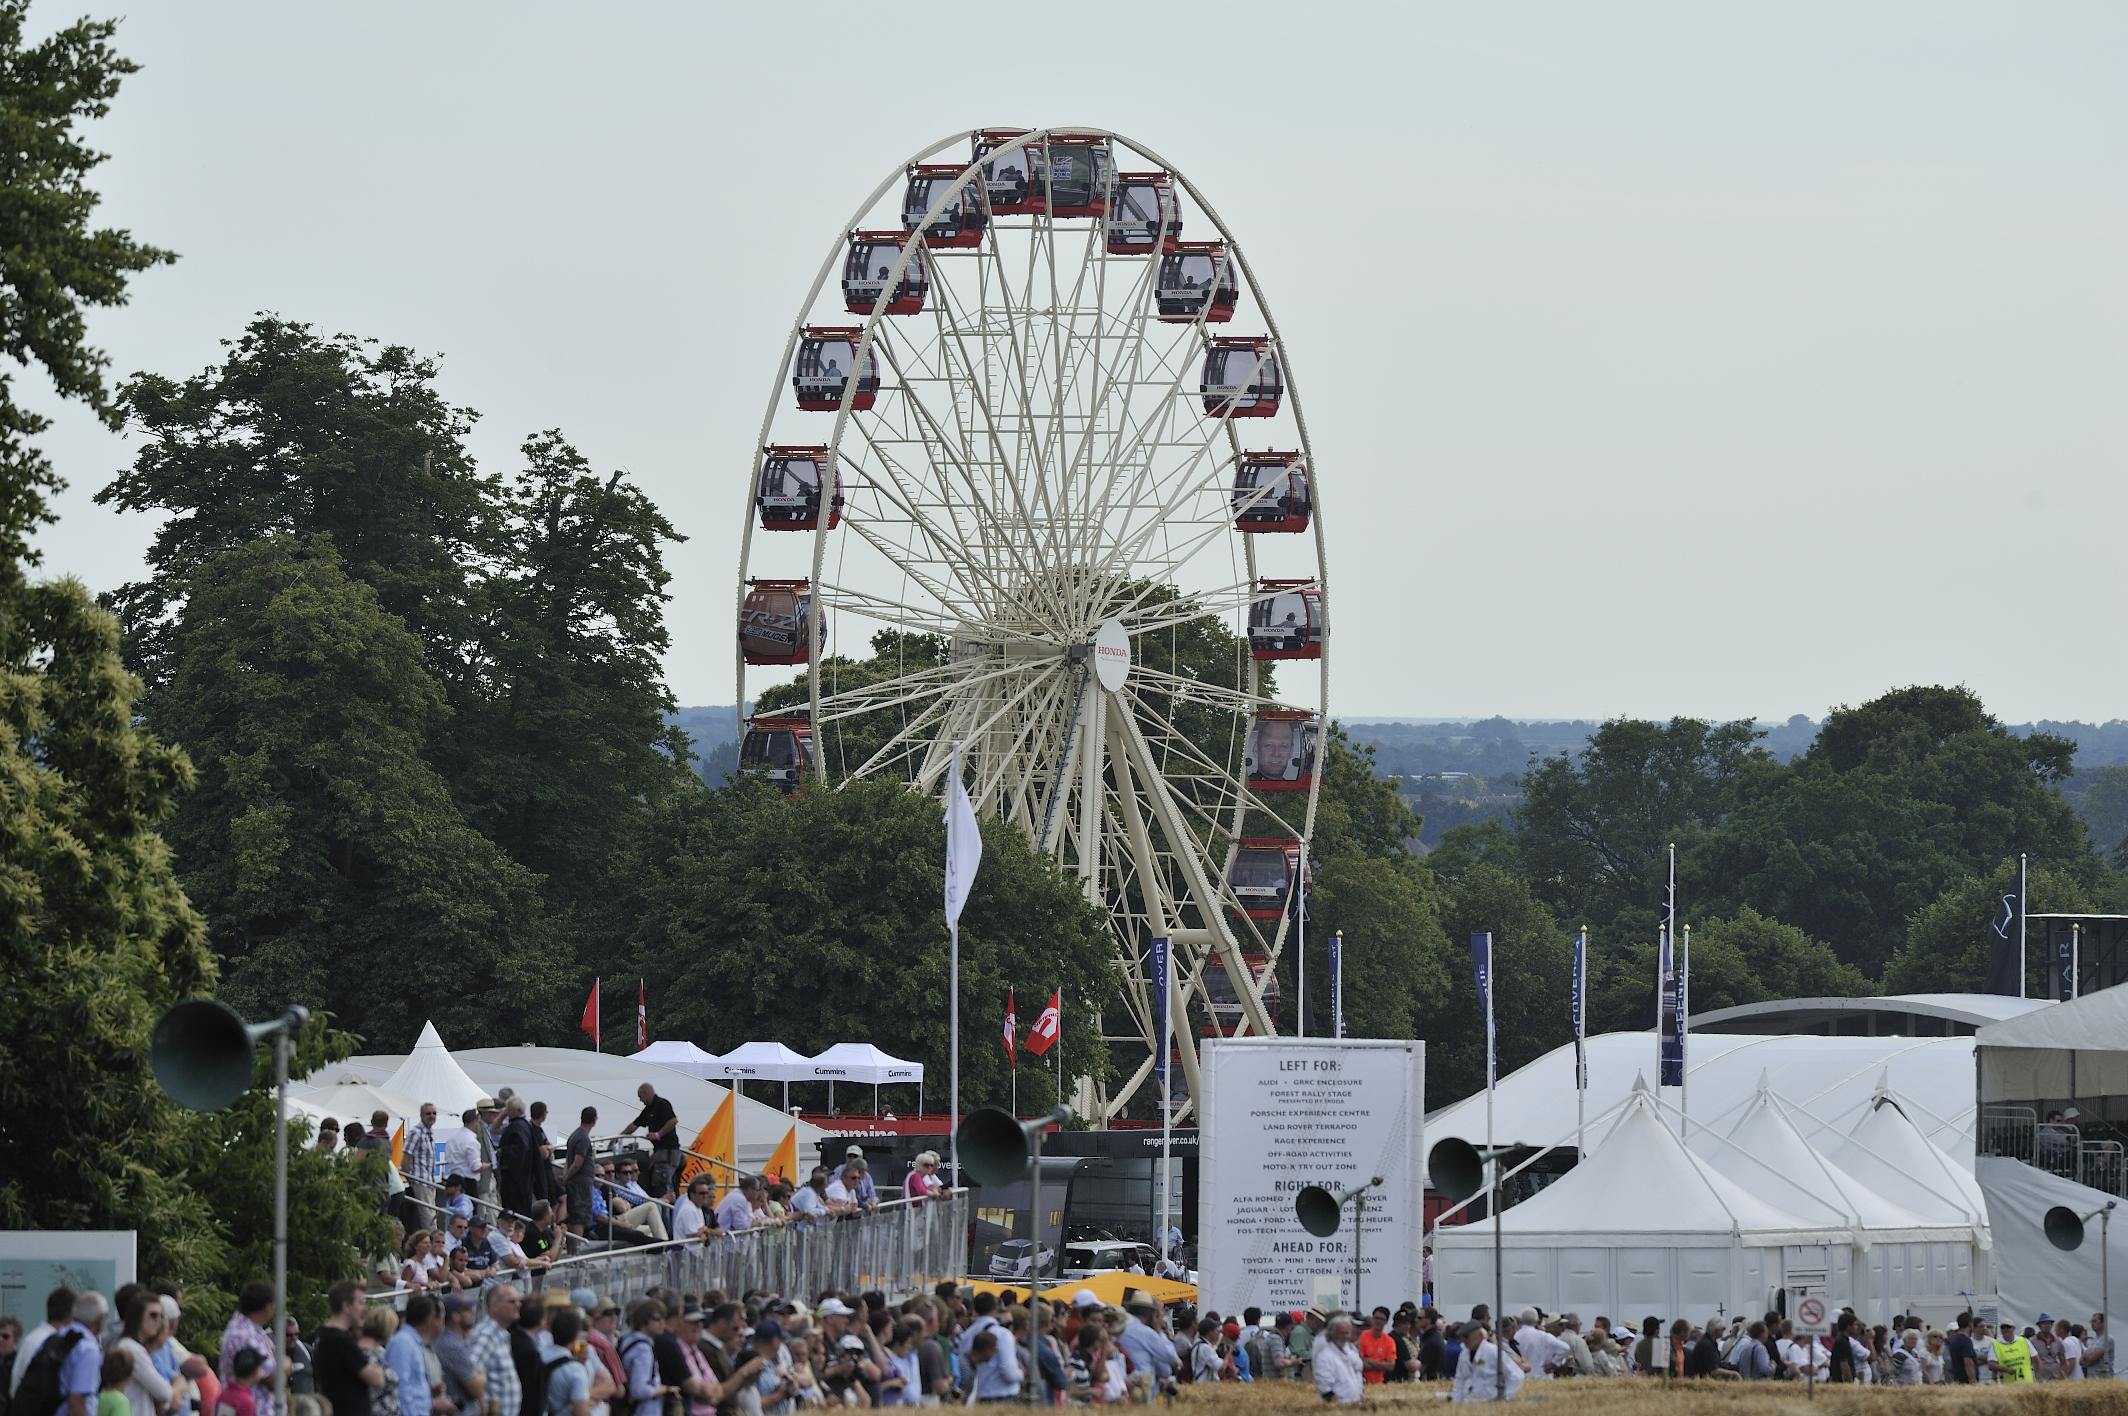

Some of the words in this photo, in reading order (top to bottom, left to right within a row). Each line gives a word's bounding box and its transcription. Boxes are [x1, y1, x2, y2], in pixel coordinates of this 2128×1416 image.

[1098, 646, 1127, 658] HONDA
[724, 1066, 756, 1074] Cmins
[1280, 1061, 1308, 1071] LEFT
[1314, 1061, 1342, 1071] FOR:
[814, 1068, 846, 1076] Cummins
[1273, 1242, 1313, 1252] AHEAD
[1320, 1242, 1347, 1252] FOR:
